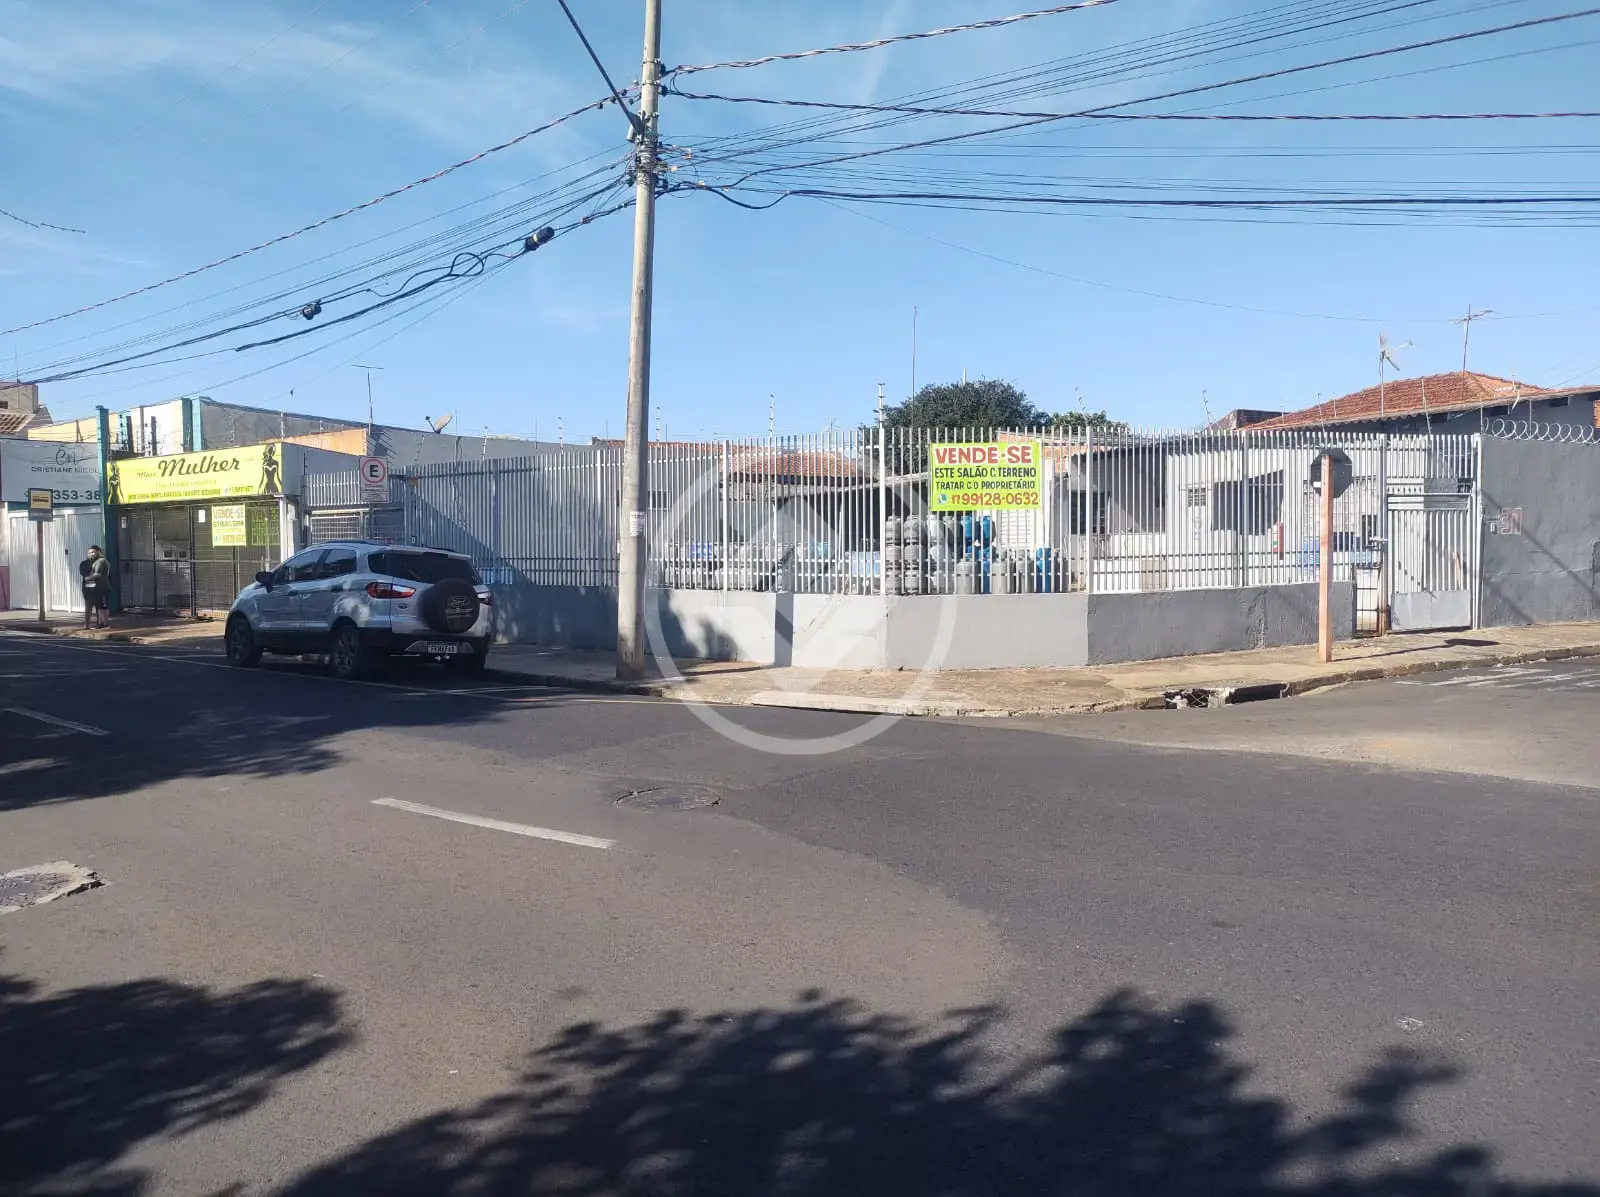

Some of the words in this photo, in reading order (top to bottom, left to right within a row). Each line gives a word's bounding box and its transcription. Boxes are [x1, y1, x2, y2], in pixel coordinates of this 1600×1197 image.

[935, 445, 1032, 464] VENDE-SE
[158, 456, 240, 477] Mulher
[369, 464, 379, 478] E
[934, 467, 954, 478] ESTE
[957, 465, 988, 478] SALÃO
[998, 466, 1036, 478] TERRENO
[936, 481, 964, 490] TRATAR
[981, 479, 1035, 490] PROPRIETÁRIO
[962, 491, 1039, 506] 99128-0632
